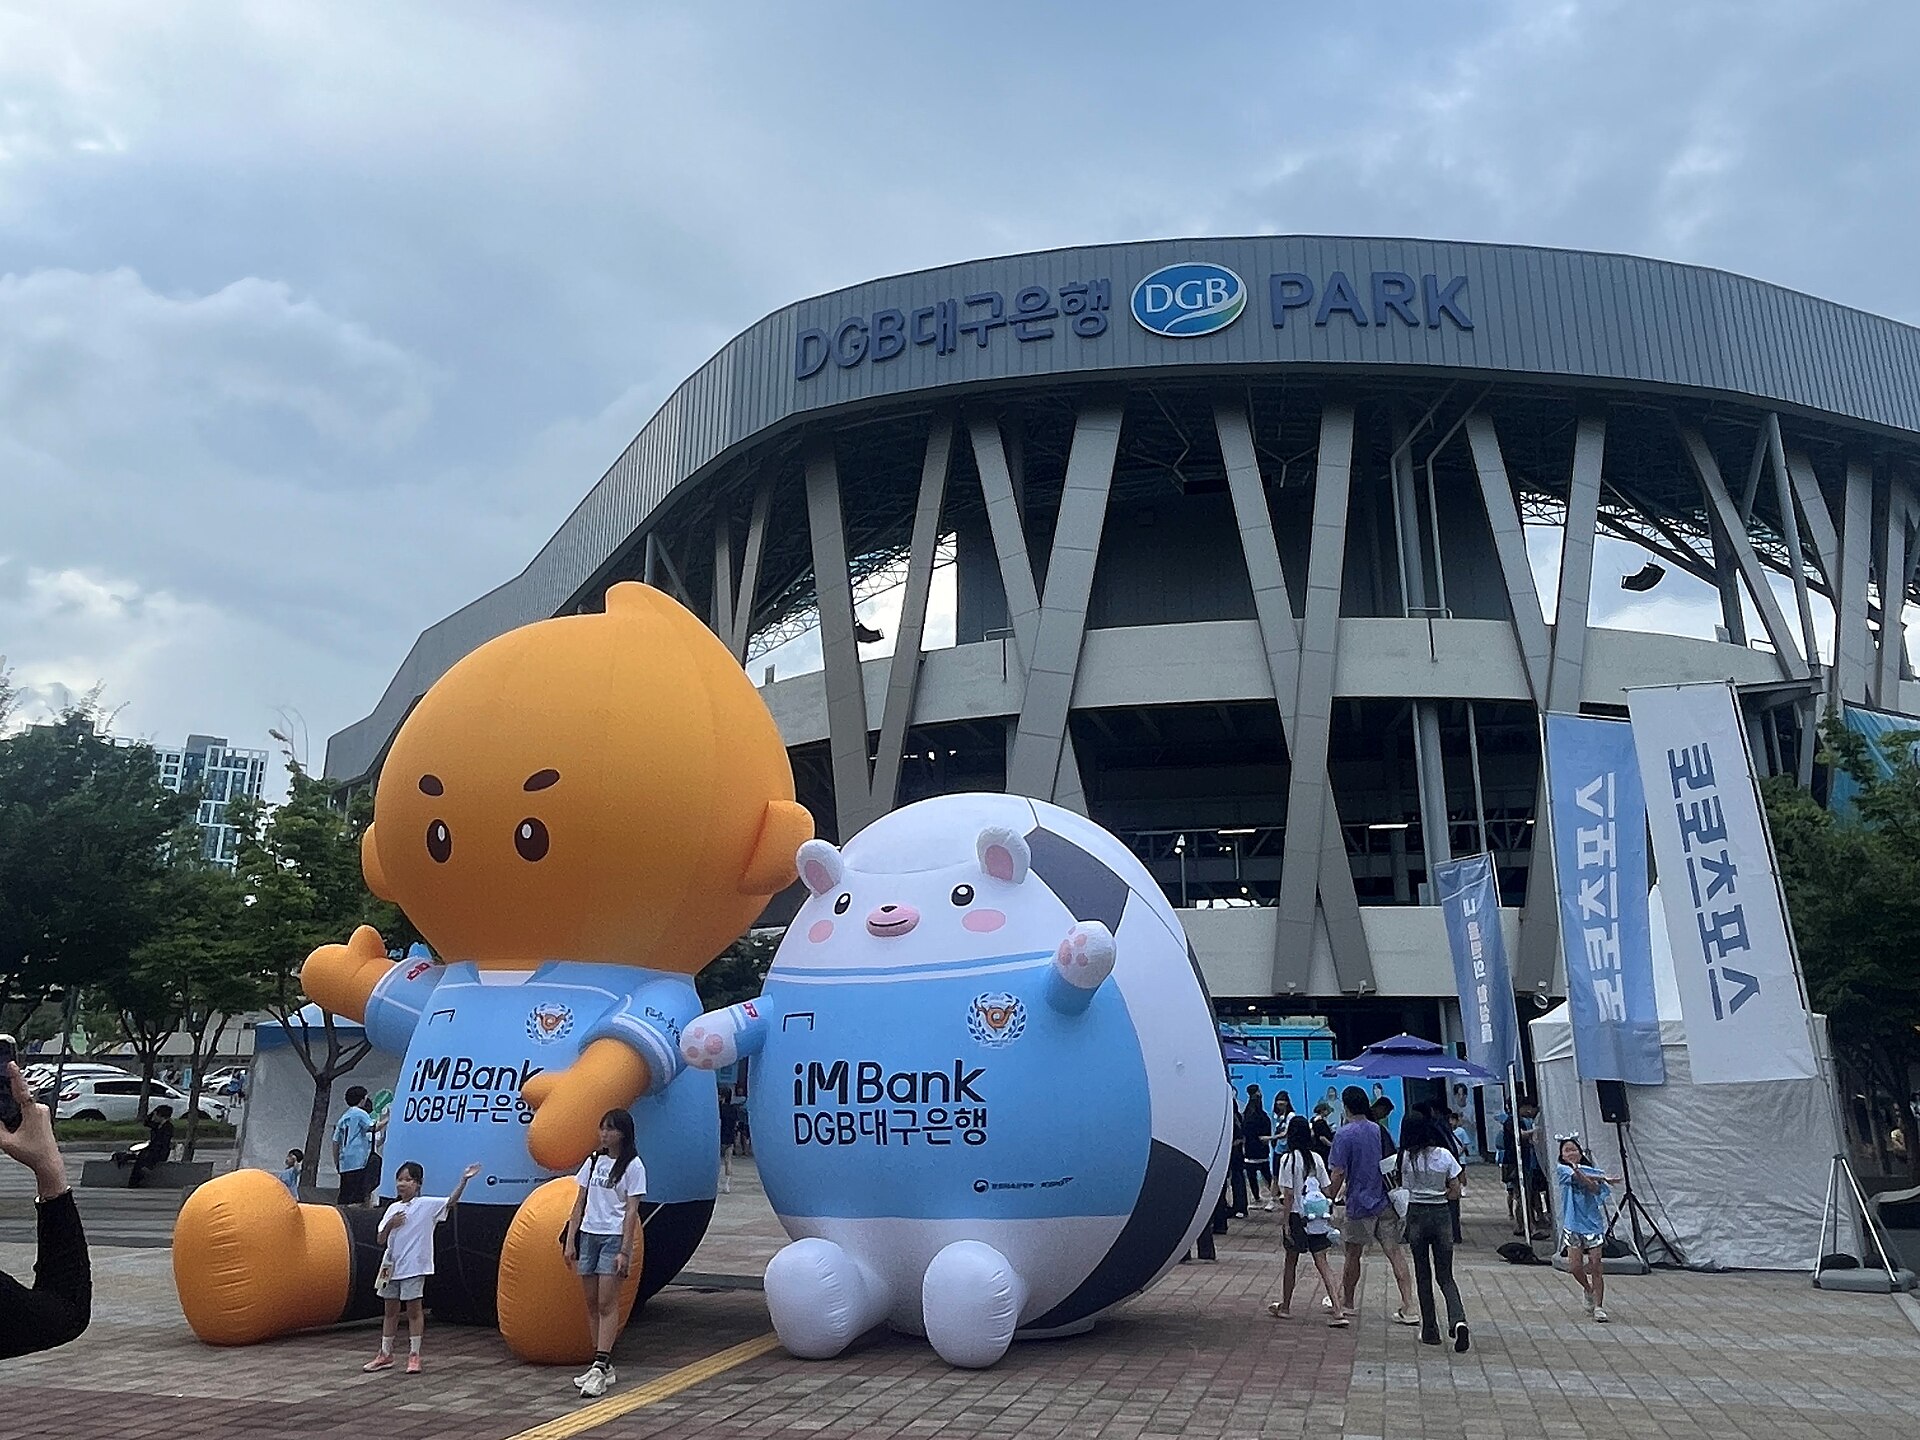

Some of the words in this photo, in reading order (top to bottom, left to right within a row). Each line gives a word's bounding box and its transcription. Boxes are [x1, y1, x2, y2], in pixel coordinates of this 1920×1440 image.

[796, 278, 1111, 381] DGB대구은행
[1145, 278, 1229, 313] DGB
[1269, 271, 1474, 331] PARK
[793, 1108, 987, 1146] DGB대구은행
